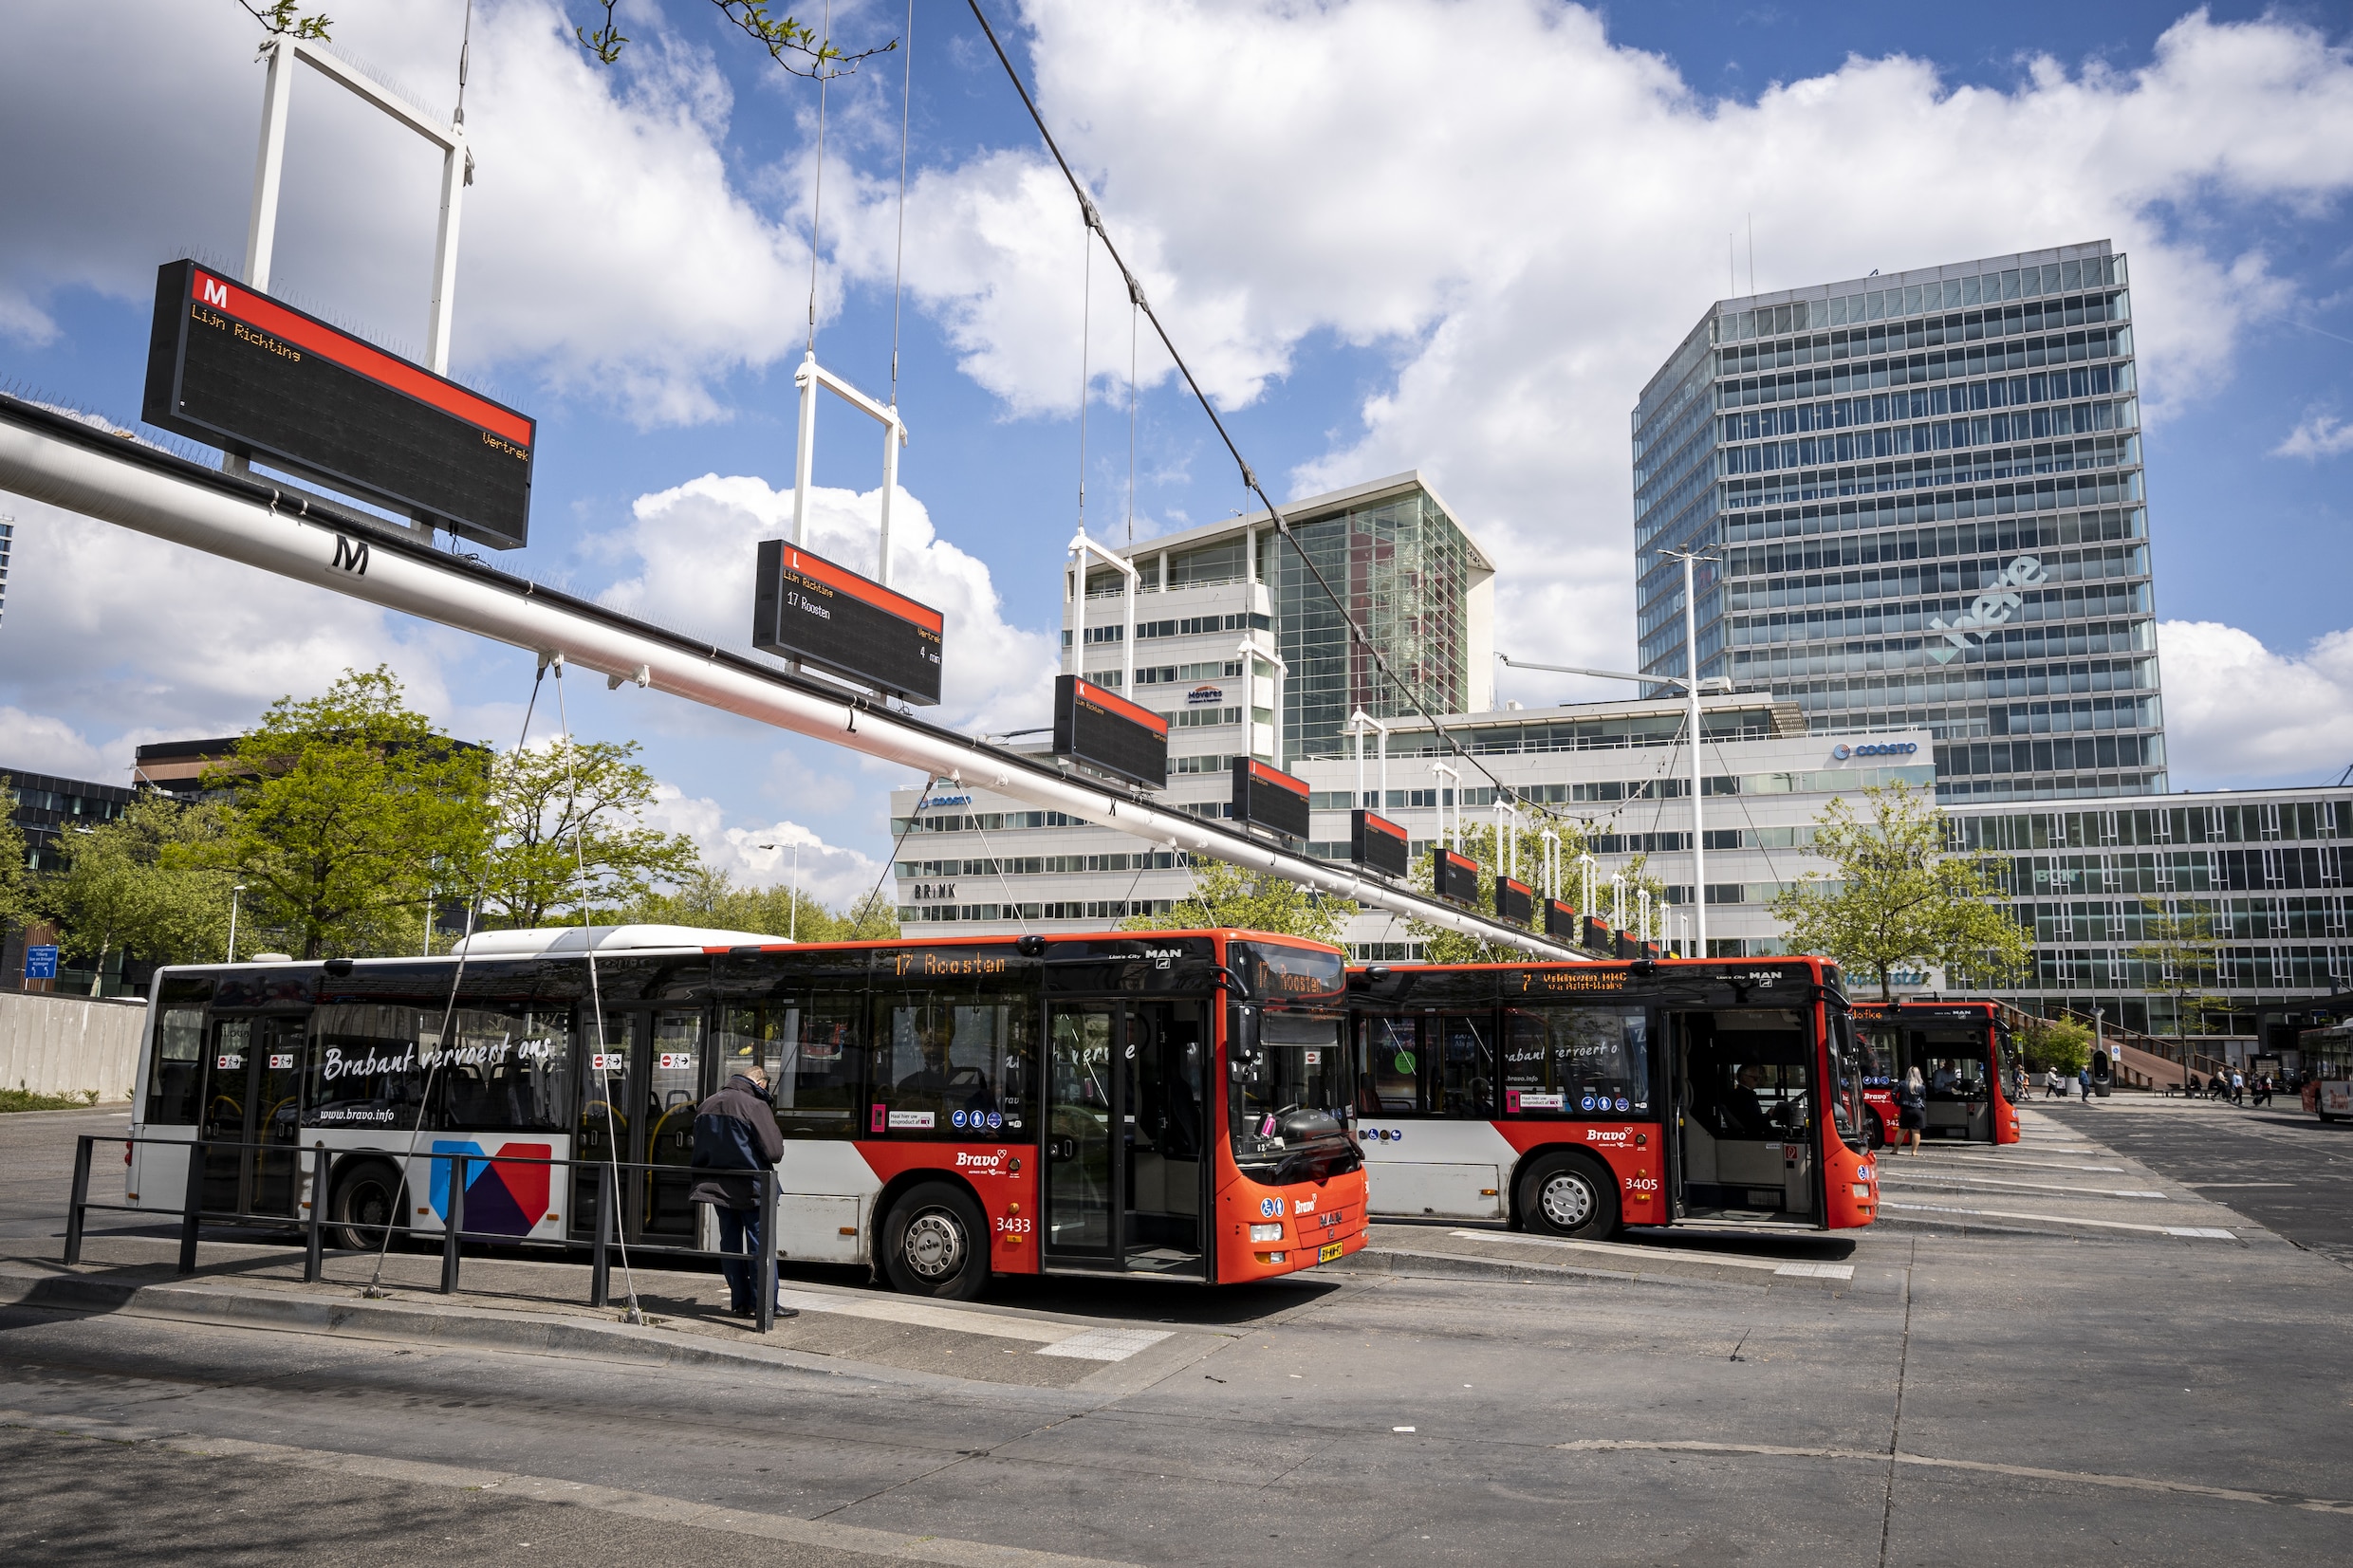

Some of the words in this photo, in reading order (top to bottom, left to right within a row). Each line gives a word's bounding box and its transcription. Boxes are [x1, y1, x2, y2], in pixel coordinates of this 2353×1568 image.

[203, 279, 227, 309] M
[192, 304, 226, 331] Lijn
[234, 323, 302, 363] Richting
[482, 432, 528, 462] Vertrek
[332, 534, 369, 576] M
[792, 551, 800, 569] L
[784, 569, 800, 584] Lijn
[803, 577, 834, 598] Richting
[787, 591, 799, 606] 17
[801, 596, 831, 619] Roosten
[1929, 556, 2048, 649] here
[920, 646, 926, 659] 4
[1079, 682, 1085, 696] K
[1188, 691, 1223, 699] Movares
[846, 709, 857, 734] L
[1856, 743, 1918, 757] COOSTO
[1145, 949, 1182, 959] MAN
[895, 953, 914, 976] 17
[924, 951, 1005, 975] Roosten
[1258, 961, 1269, 988] 17
[1280, 963, 1323, 994] Roosten
[1522, 973, 1532, 992] 7
[1602, 971, 1628, 982] MMC
[1749, 971, 1783, 980] MAN
[323, 1042, 415, 1080] Brabant
[420, 1032, 512, 1070] vervoert
[517, 1037, 551, 1060] ons
[320, 1108, 395, 1121] www.bravo.info
[1585, 1129, 1627, 1141] Bravo
[955, 1152, 1000, 1167] Bravo
[1625, 1177, 1658, 1190] 3405
[1294, 1200, 1315, 1214] Bravo
[996, 1217, 1031, 1232] 3433
[1319, 1211, 1343, 1227] MAN
